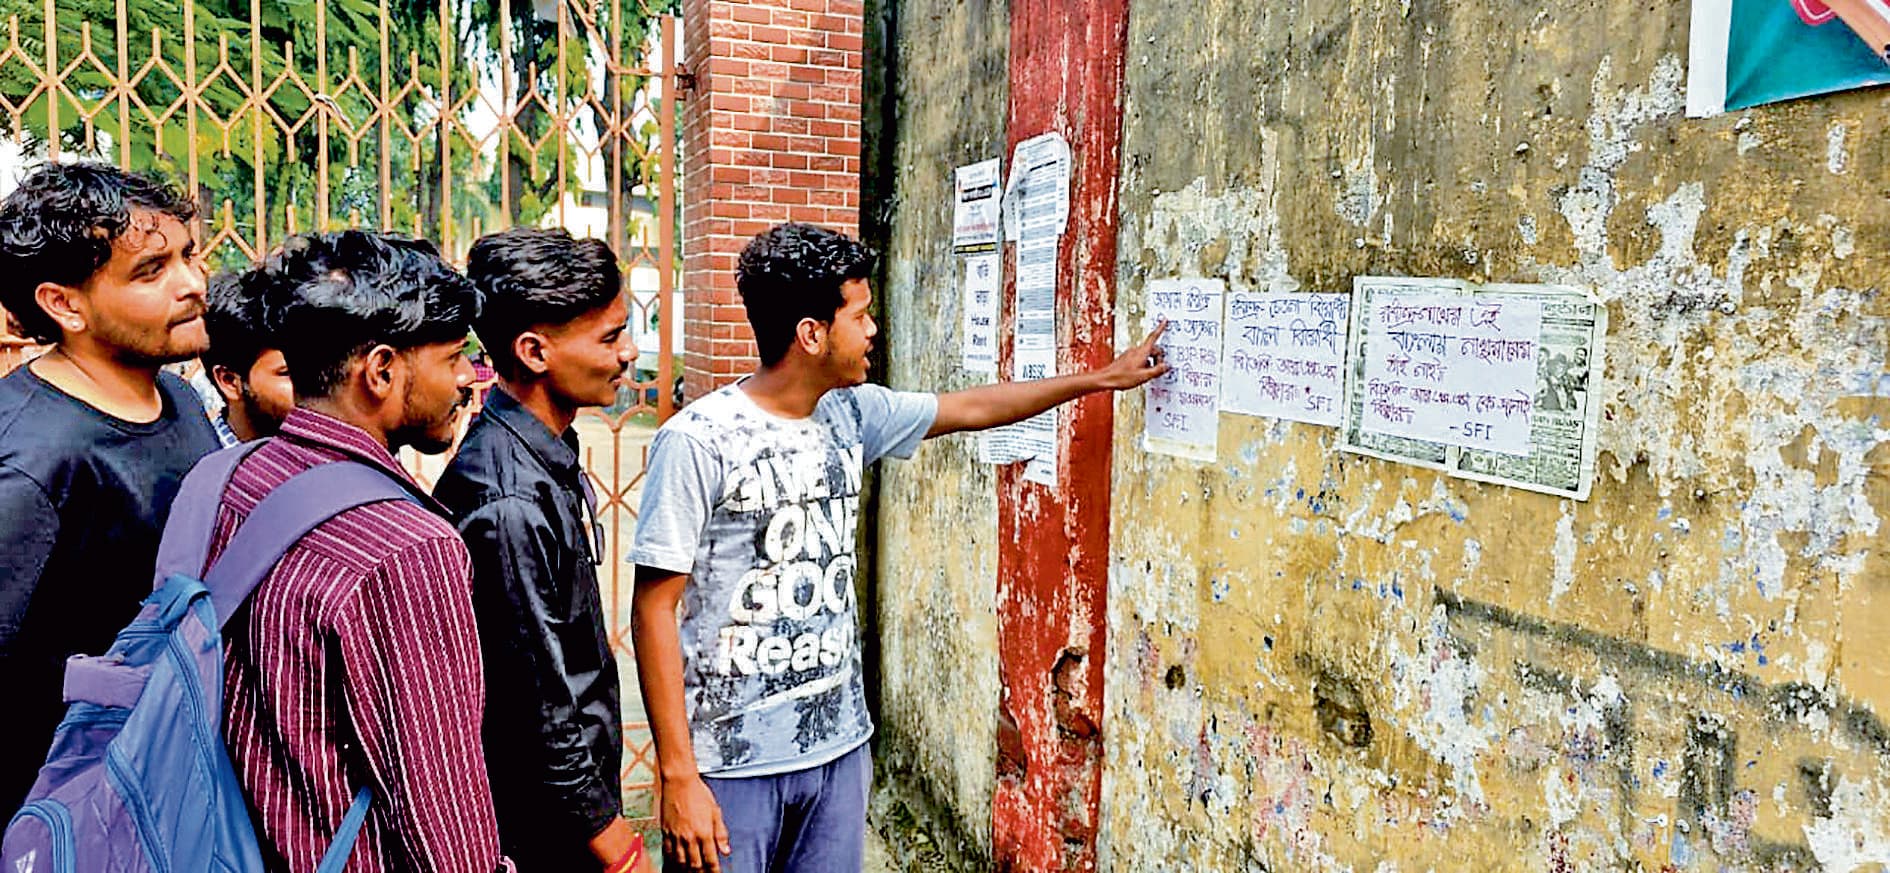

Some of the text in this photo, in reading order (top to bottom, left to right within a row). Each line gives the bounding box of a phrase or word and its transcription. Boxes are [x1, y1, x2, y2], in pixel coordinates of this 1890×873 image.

[1304, 395, 1333, 412] SFI
[728, 554, 857, 626] GOO
[718, 623, 850, 677] Reas
